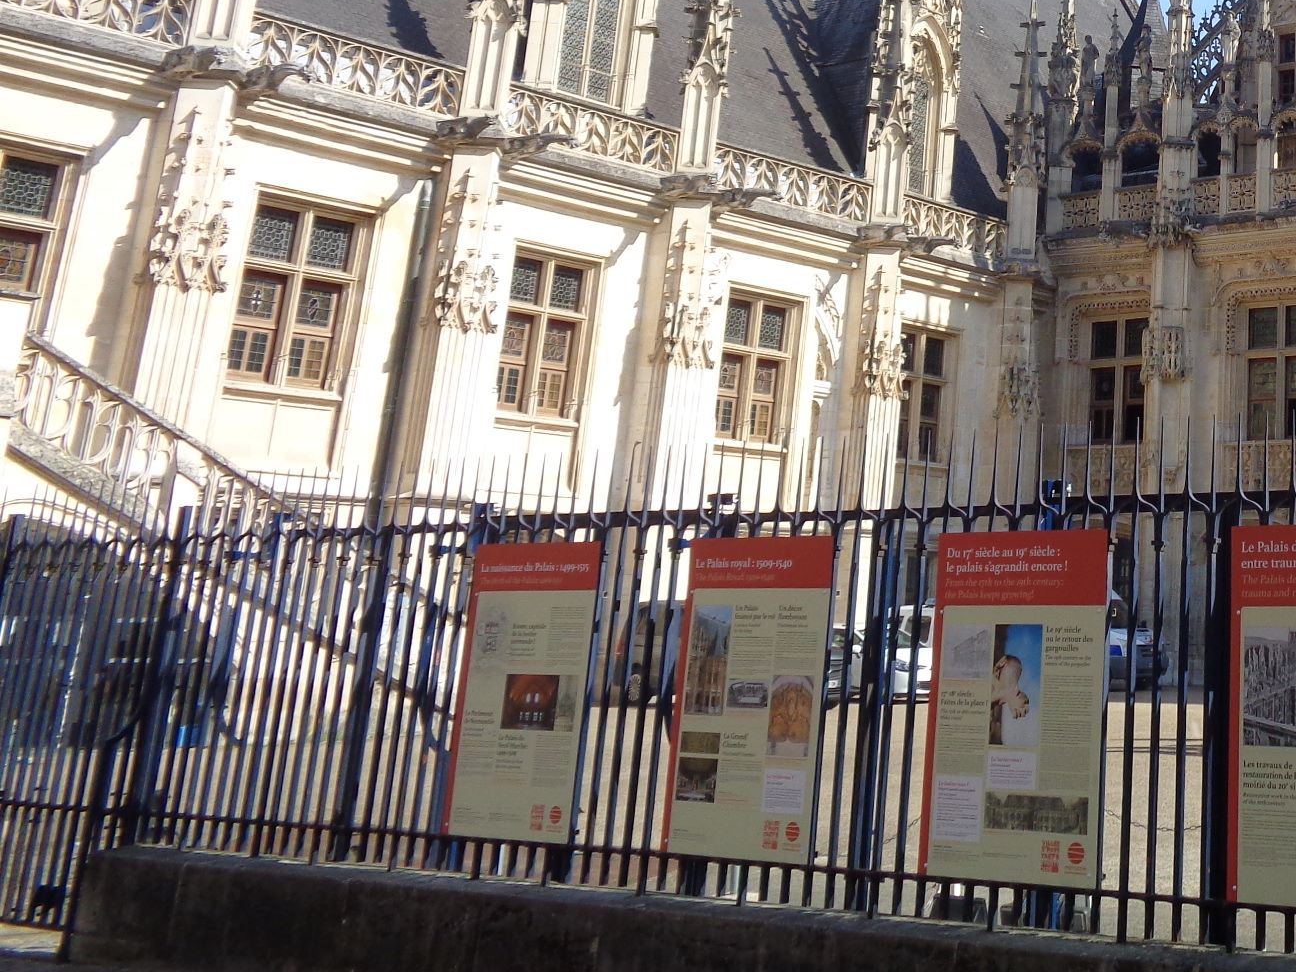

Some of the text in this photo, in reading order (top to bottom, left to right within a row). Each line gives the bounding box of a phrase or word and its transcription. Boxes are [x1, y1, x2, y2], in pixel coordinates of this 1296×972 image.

[947, 547, 961, 558] Du
[975, 546, 1000, 558] siècle
[1002, 549, 1013, 557] au
[1029, 545, 1055, 557] siècle
[1241, 541, 1254, 554] Le
[1257, 541, 1289, 553] Palais
[535, 562, 555, 572] Palais
[695, 559, 705, 569] Le
[706, 558, 729, 568] Palais
[730, 557, 751, 570] royal
[756, 559, 793, 570] 1509-1540
[946, 561, 954, 573] le
[956, 561, 983, 576] palais
[984, 560, 1029, 575] s'agrandit
[1031, 563, 1062, 572] encore
[1241, 558, 1269, 569] entre
[1242, 574, 1258, 585] The
[1260, 574, 1285, 585] Palais
[1241, 589, 1272, 598] trauma
[1274, 587, 1291, 598] and
[1256, 761, 1283, 770] travaux
[1283, 760, 1293, 769] de
[1243, 772, 1283, 780] restauration
[1284, 772, 1293, 781] de
[1266, 781, 1277, 790] du
